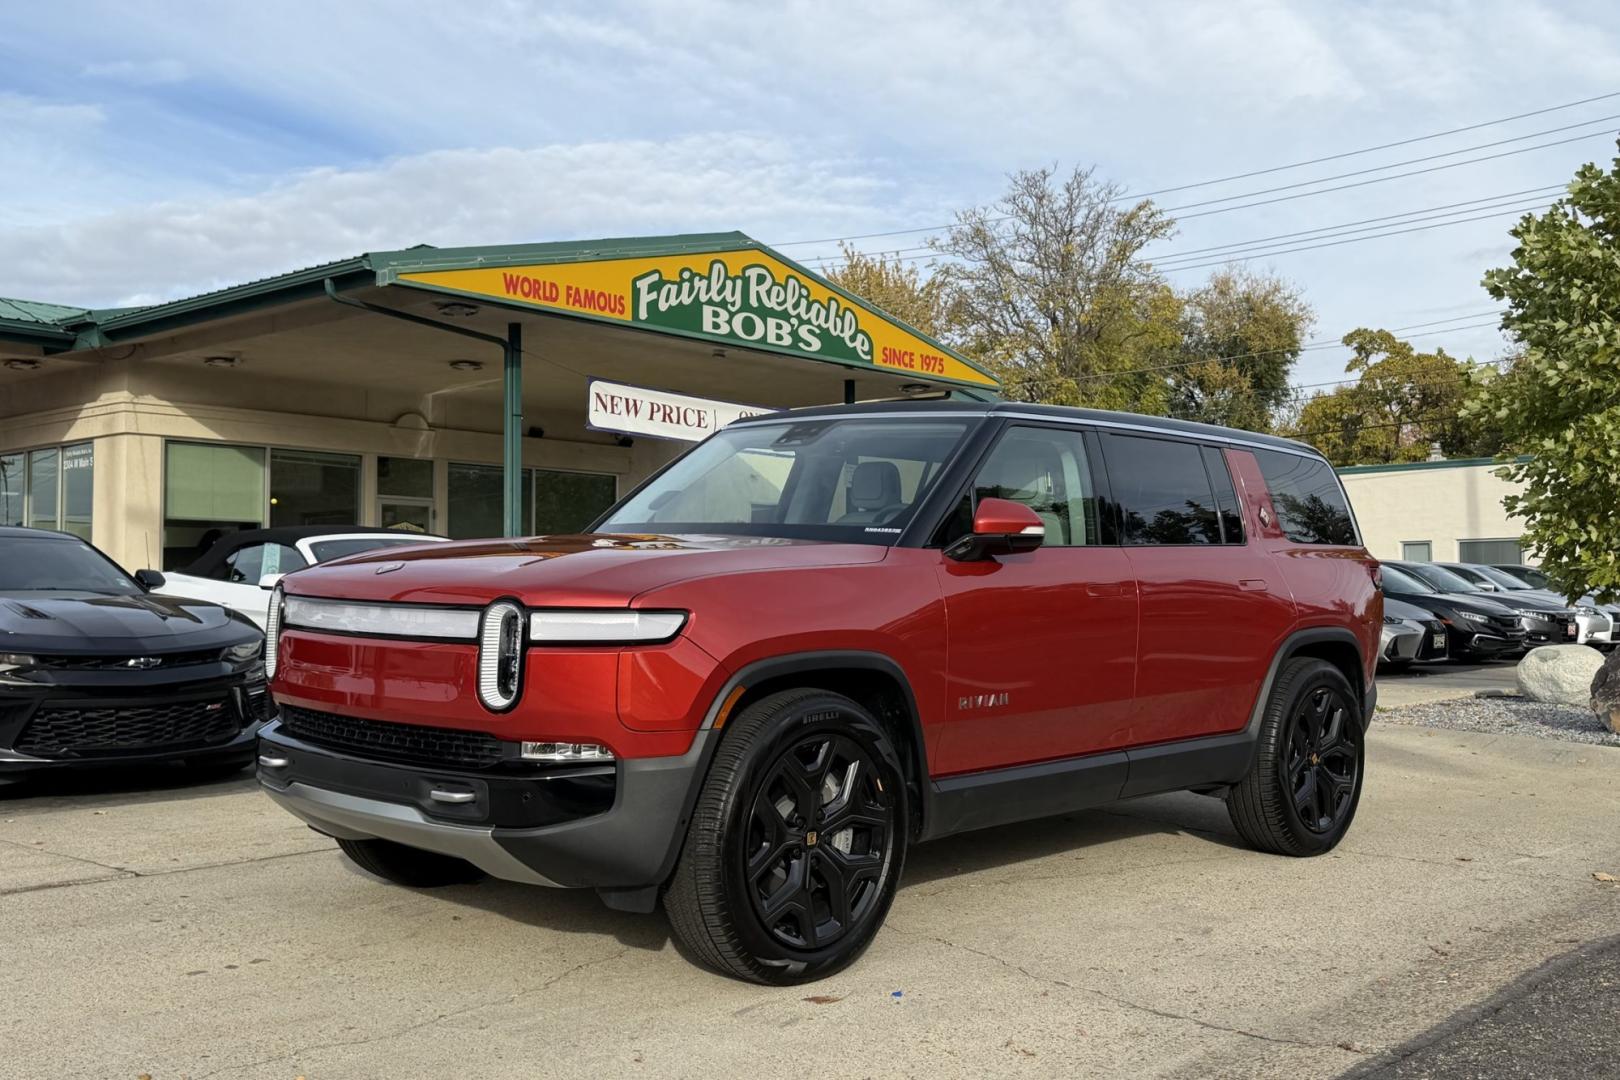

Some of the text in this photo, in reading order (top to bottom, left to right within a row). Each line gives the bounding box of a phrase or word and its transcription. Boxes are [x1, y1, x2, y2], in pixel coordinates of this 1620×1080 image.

[503, 272, 625, 315] WORLD FAMOUS
[636, 262, 871, 360] Fairly Reliable
[702, 305, 822, 352] BOB'S
[882, 346, 945, 374] SINCE 1975
[594, 392, 709, 429] NEW PRICE
[803, 711, 840, 724] PIRELLI
[959, 693, 1008, 710] RIVIAN
